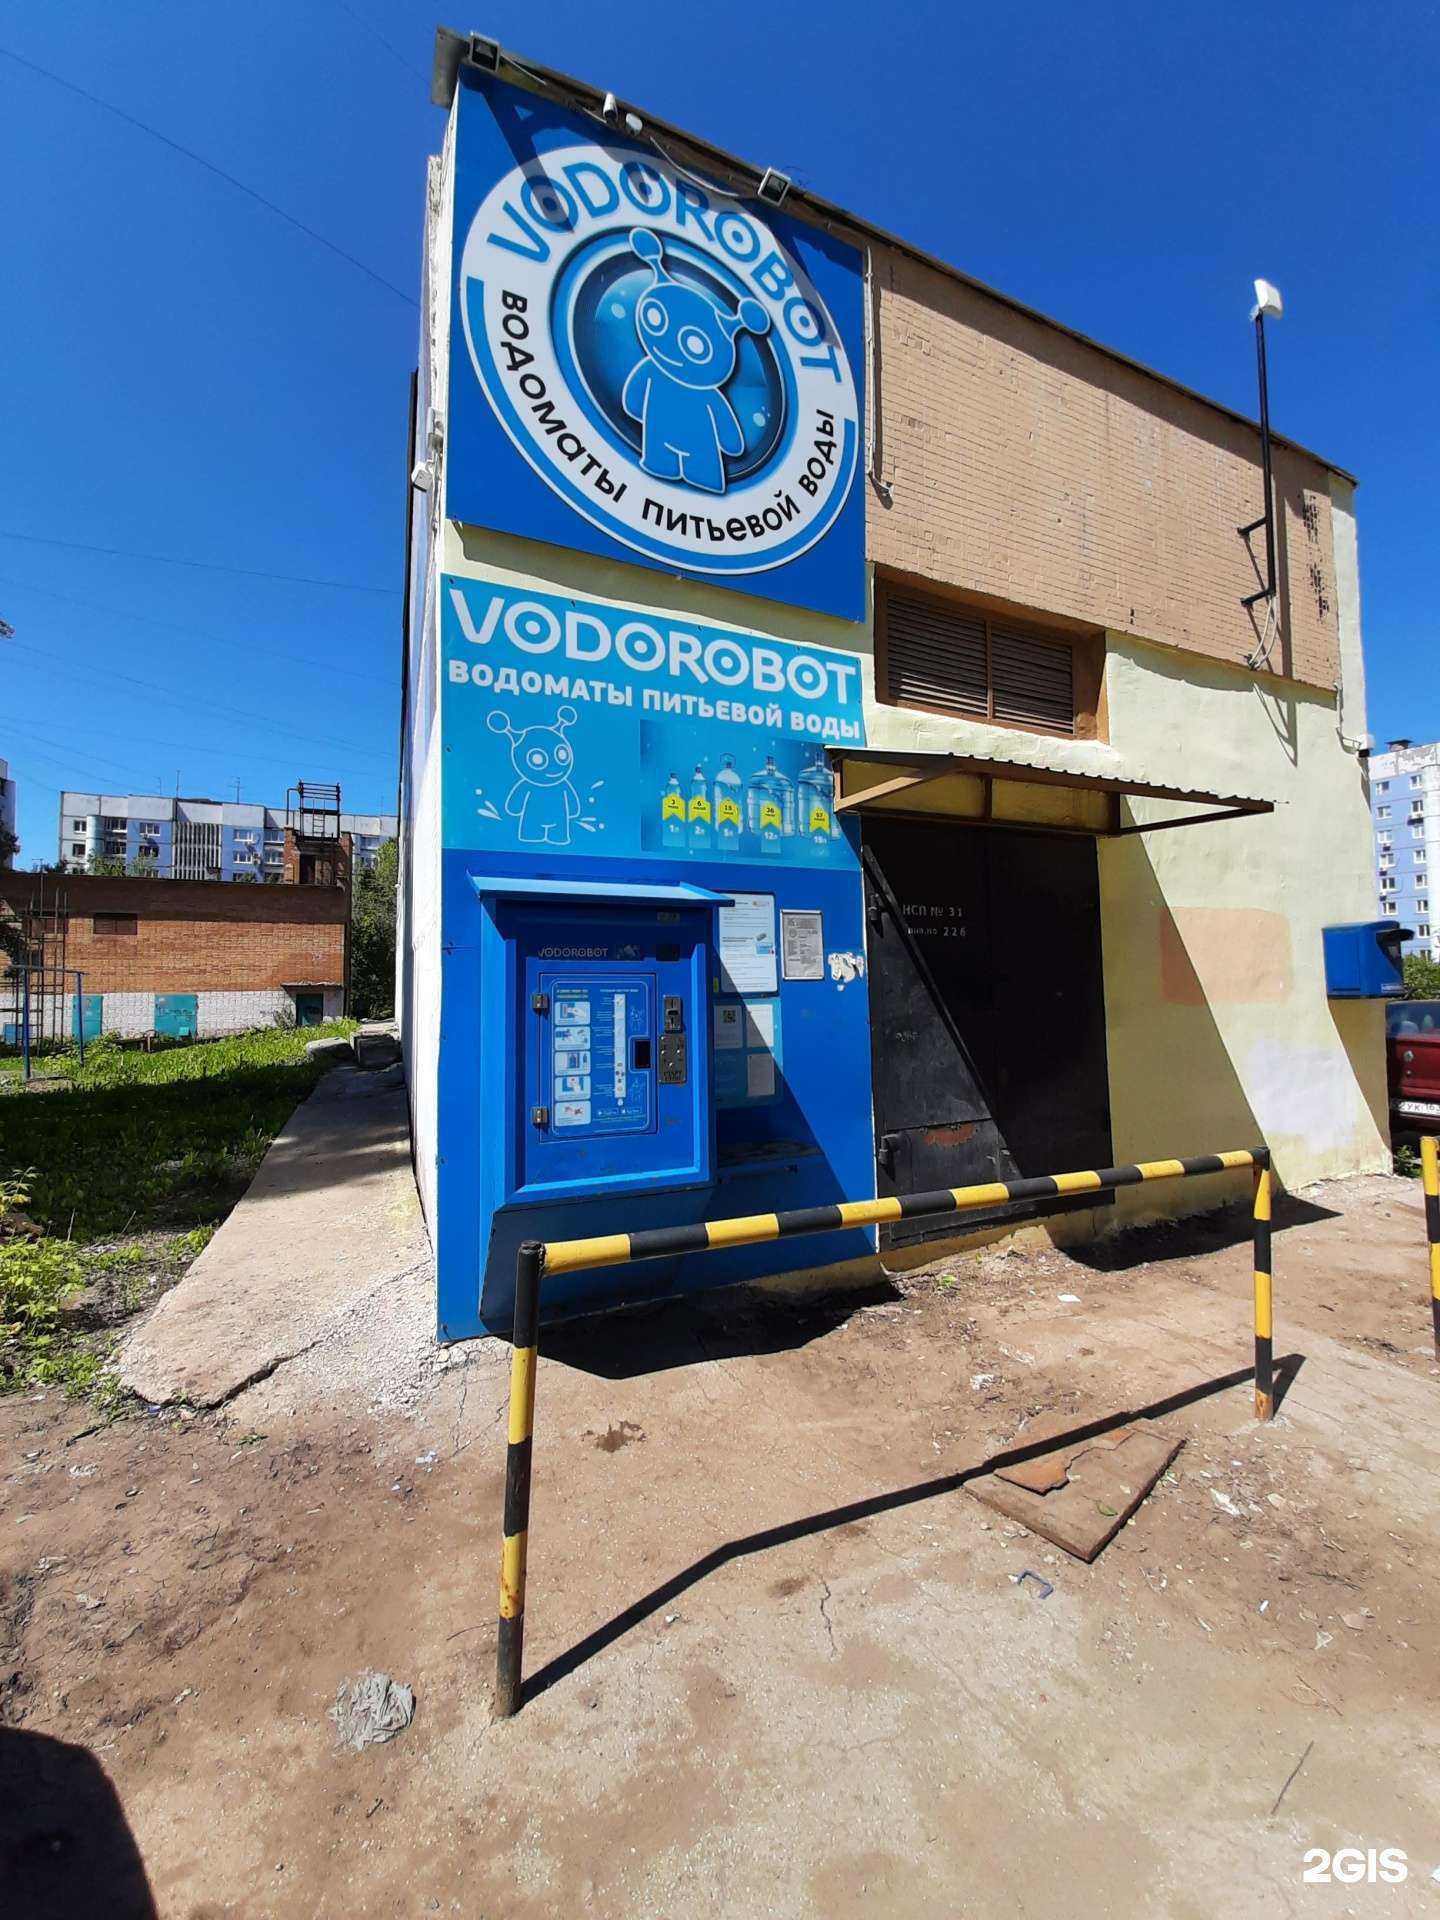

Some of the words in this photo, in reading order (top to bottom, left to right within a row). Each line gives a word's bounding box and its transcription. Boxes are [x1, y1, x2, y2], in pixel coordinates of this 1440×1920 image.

[486, 160, 842, 385] VODOROBOT
[450, 588, 857, 704] VODOROBOT
[448, 660, 633, 706] ВОДОМАТЫ
[642, 688, 782, 729] ПИТЬЕВОЙ
[790, 711, 860, 740] ВОДЫ
[538, 947, 609, 959] VODOROBOT
